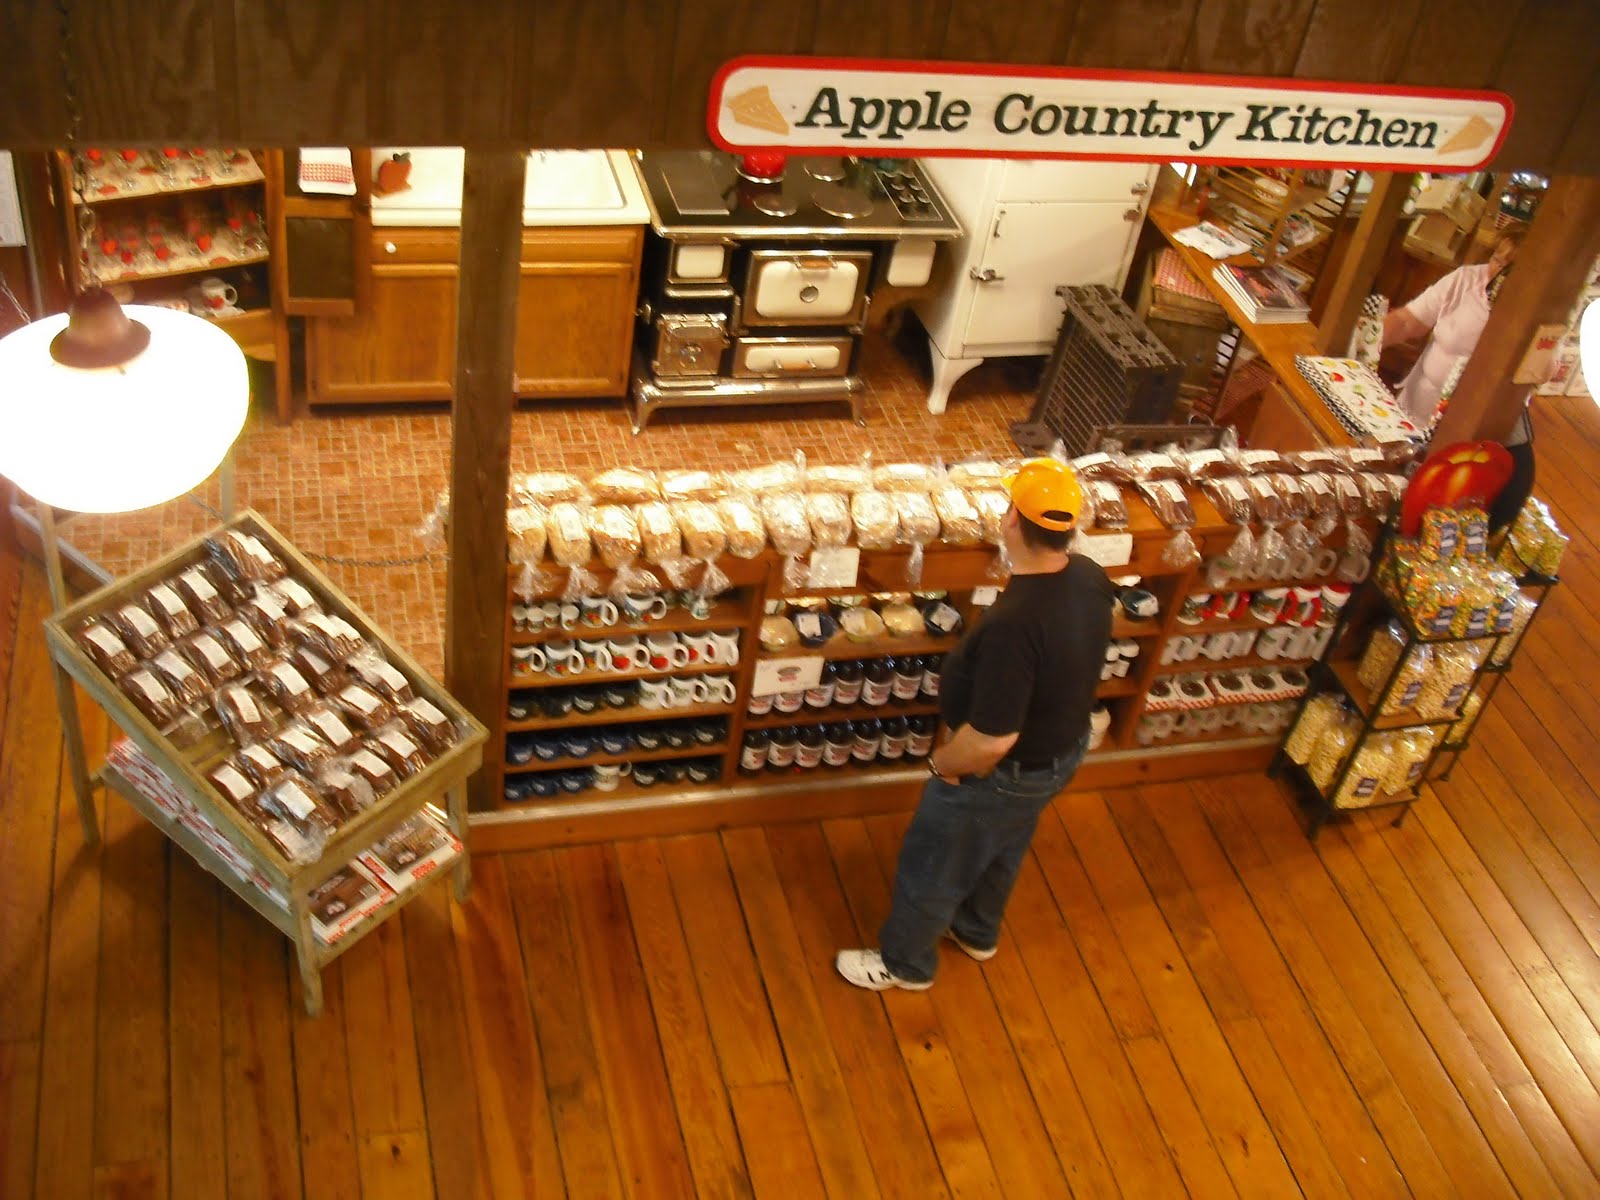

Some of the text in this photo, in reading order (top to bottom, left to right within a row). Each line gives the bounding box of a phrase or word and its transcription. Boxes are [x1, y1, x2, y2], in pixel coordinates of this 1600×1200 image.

[795, 87, 1439, 151] Apple Country Kitchen
